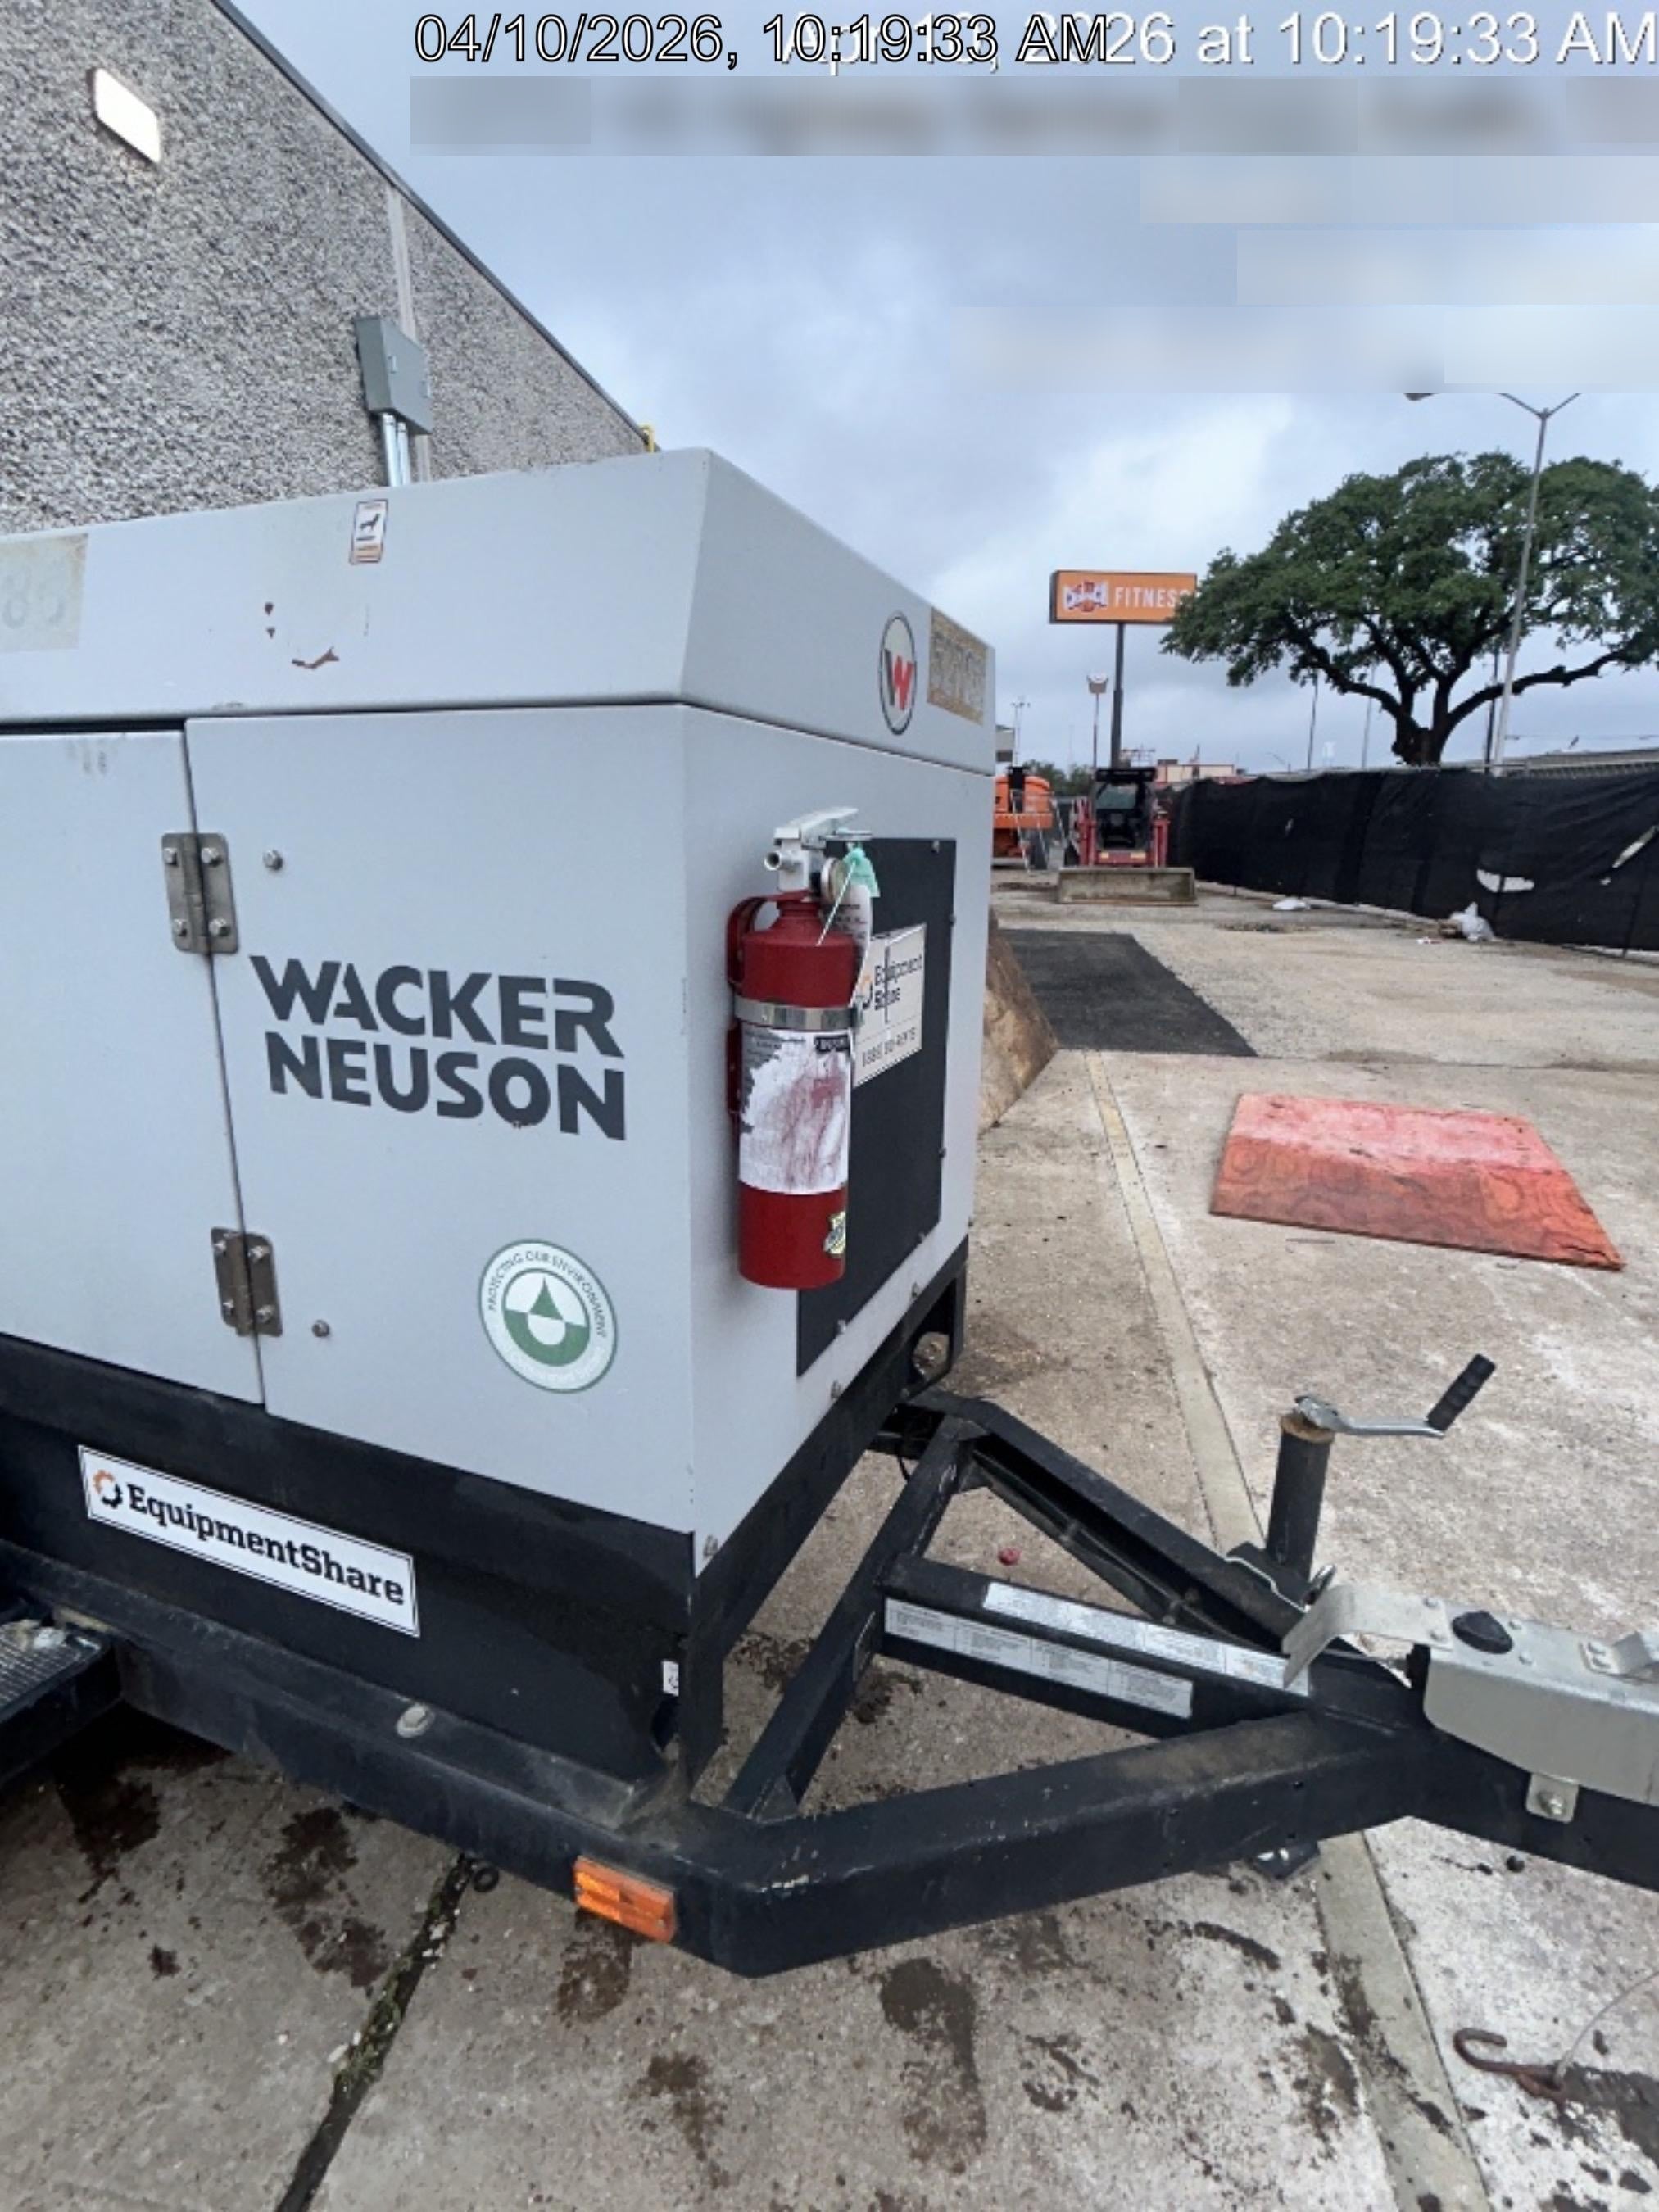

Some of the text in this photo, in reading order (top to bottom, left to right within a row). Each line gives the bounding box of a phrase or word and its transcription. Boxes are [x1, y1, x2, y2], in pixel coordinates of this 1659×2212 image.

[249, 954, 625, 1058] WACKER
[265, 1031, 626, 1141] NEUSON
[126, 1484, 405, 1606] EquipmentShare
